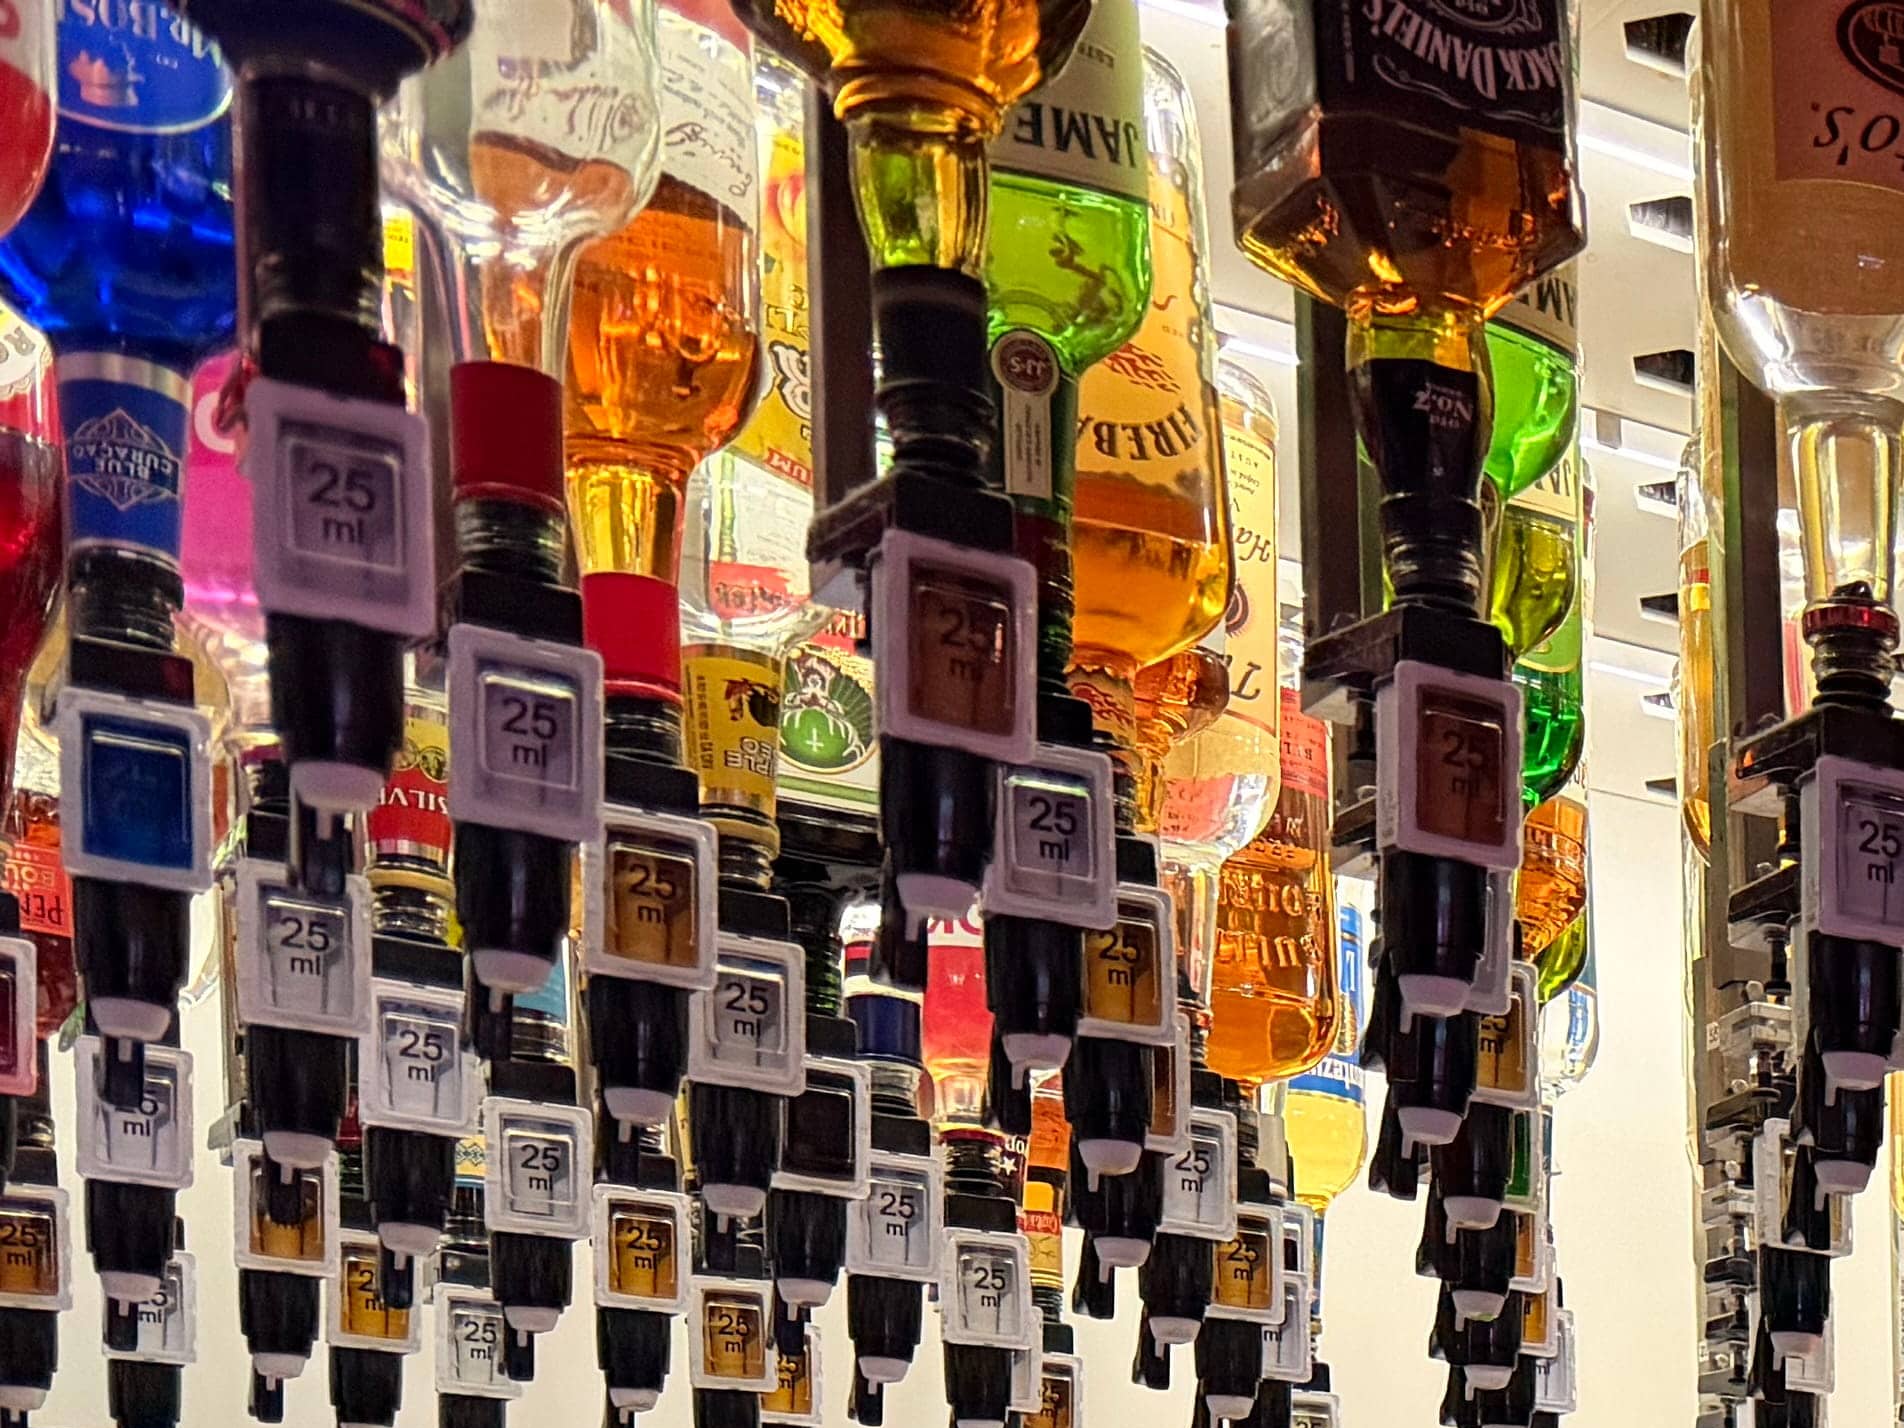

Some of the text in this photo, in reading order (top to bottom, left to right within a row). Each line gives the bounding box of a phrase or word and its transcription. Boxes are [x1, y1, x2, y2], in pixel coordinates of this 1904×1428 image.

[1012, 102, 1140, 172] JAME
[1078, 404, 1200, 461] FIREB
[94, 457, 149, 484] BLUE
[308, 462, 374, 512] 25
[322, 511, 364, 547] ml
[501, 696, 558, 742] 25
[512, 741, 547, 769] ml
[383, 786, 449, 814] SILV
[1028, 798, 1076, 835] 25
[1039, 837, 1069, 862] ml
[1858, 822, 1901, 857] 25
[628, 866, 676, 899] 25
[1867, 859, 1894, 884] ml
[280, 917, 328, 949] 25
[1099, 932, 1137, 964] 25
[291, 951, 321, 975] ml
[725, 984, 769, 1014] 25
[734, 1016, 761, 1036] ml
[400, 1032, 443, 1061] 25
[407, 1061, 434, 1081] ml
[123, 1114, 150, 1137] ml
[521, 1145, 559, 1170] 25
[1175, 1152, 1210, 1175] 25
[528, 1172, 553, 1191] ml
[881, 1194, 914, 1219] 25
[0, 1224, 38, 1247] 25
[627, 1226, 663, 1251] 25
[886, 1219, 909, 1238] ml
[6, 1249, 31, 1267] ml
[636, 1253, 658, 1270] ml
[1227, 1240, 1260, 1264] 25
[974, 1268, 1006, 1292] 25
[462, 1320, 497, 1344] 25
[719, 1314, 750, 1337] 25
[470, 1344, 492, 1361] ml
